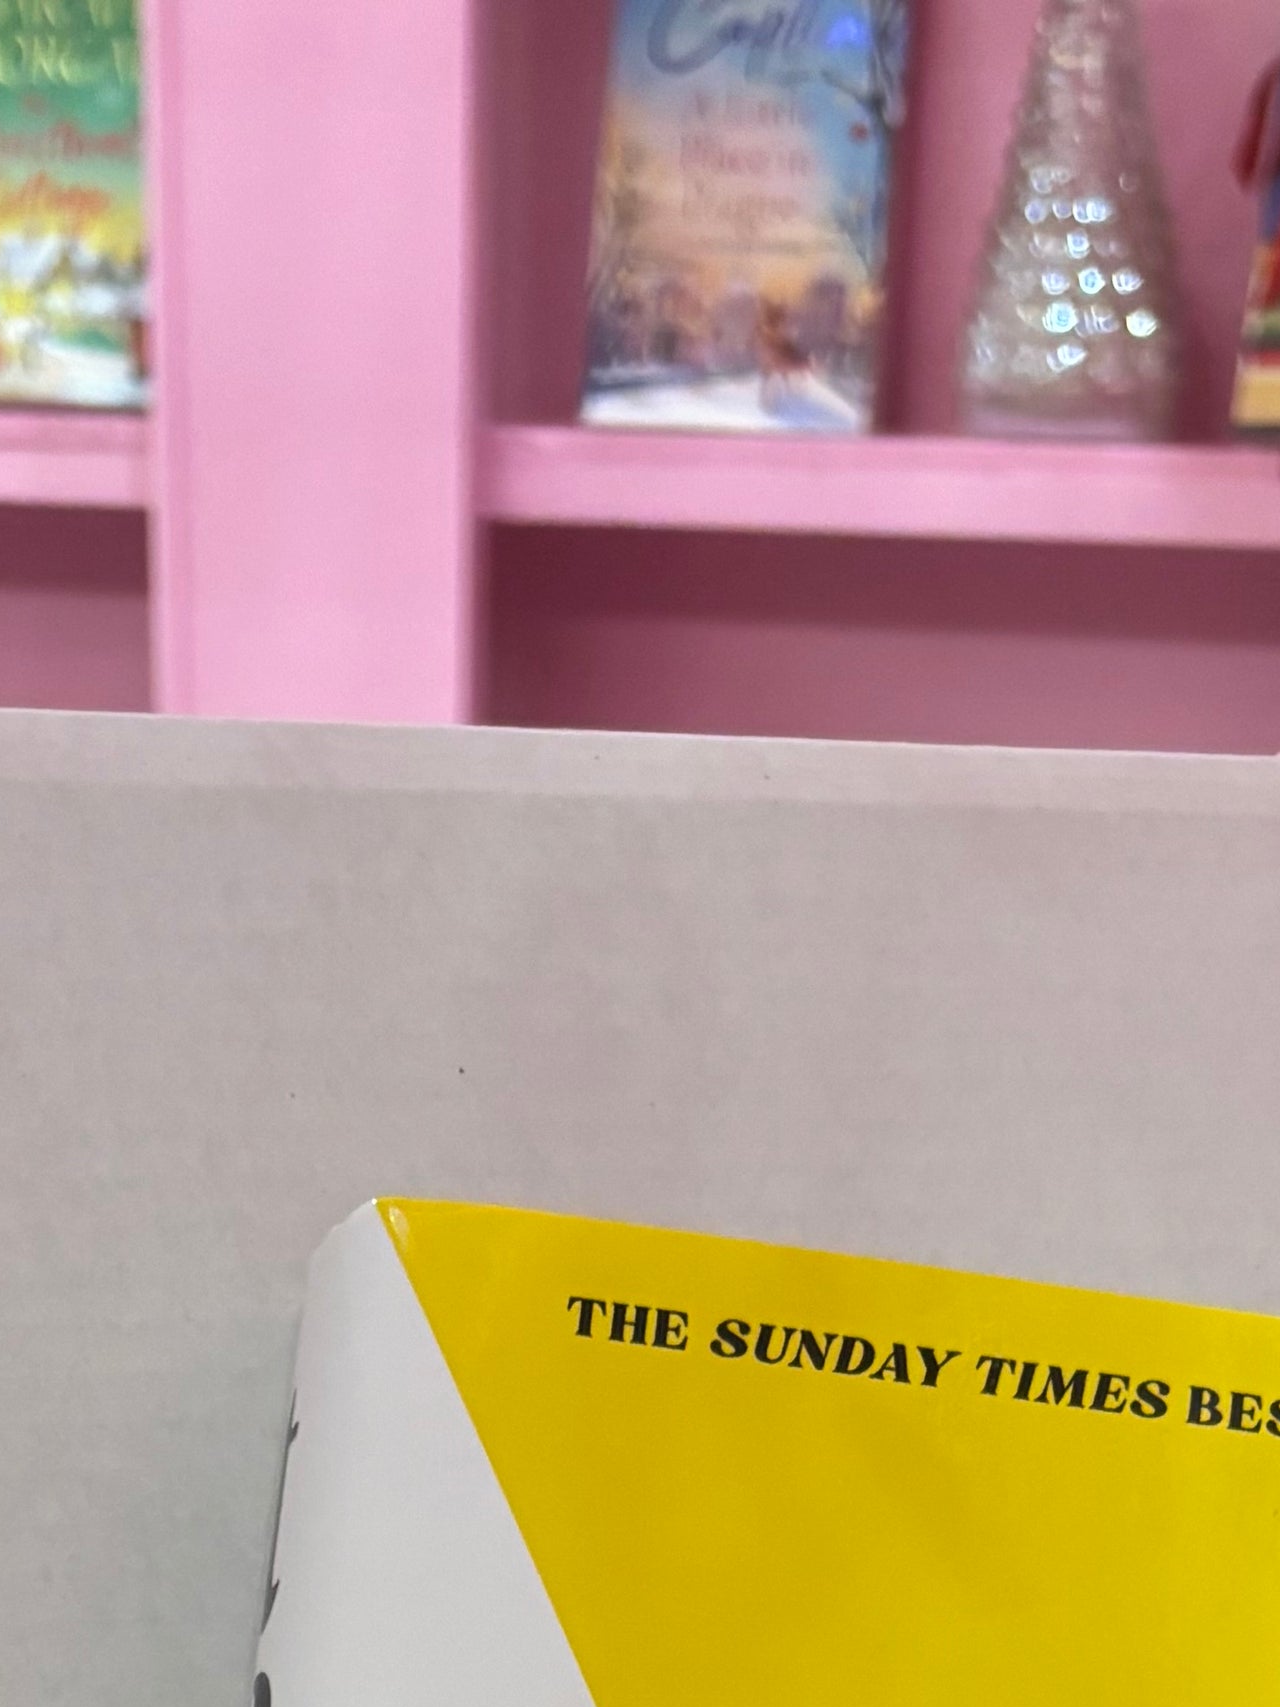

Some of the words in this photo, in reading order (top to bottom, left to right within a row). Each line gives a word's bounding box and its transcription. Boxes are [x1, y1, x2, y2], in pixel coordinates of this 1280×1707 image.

[567, 1296, 688, 1351] THE
[709, 1319, 961, 1389] SUNDAY
[975, 1355, 1169, 1419] TIMES
